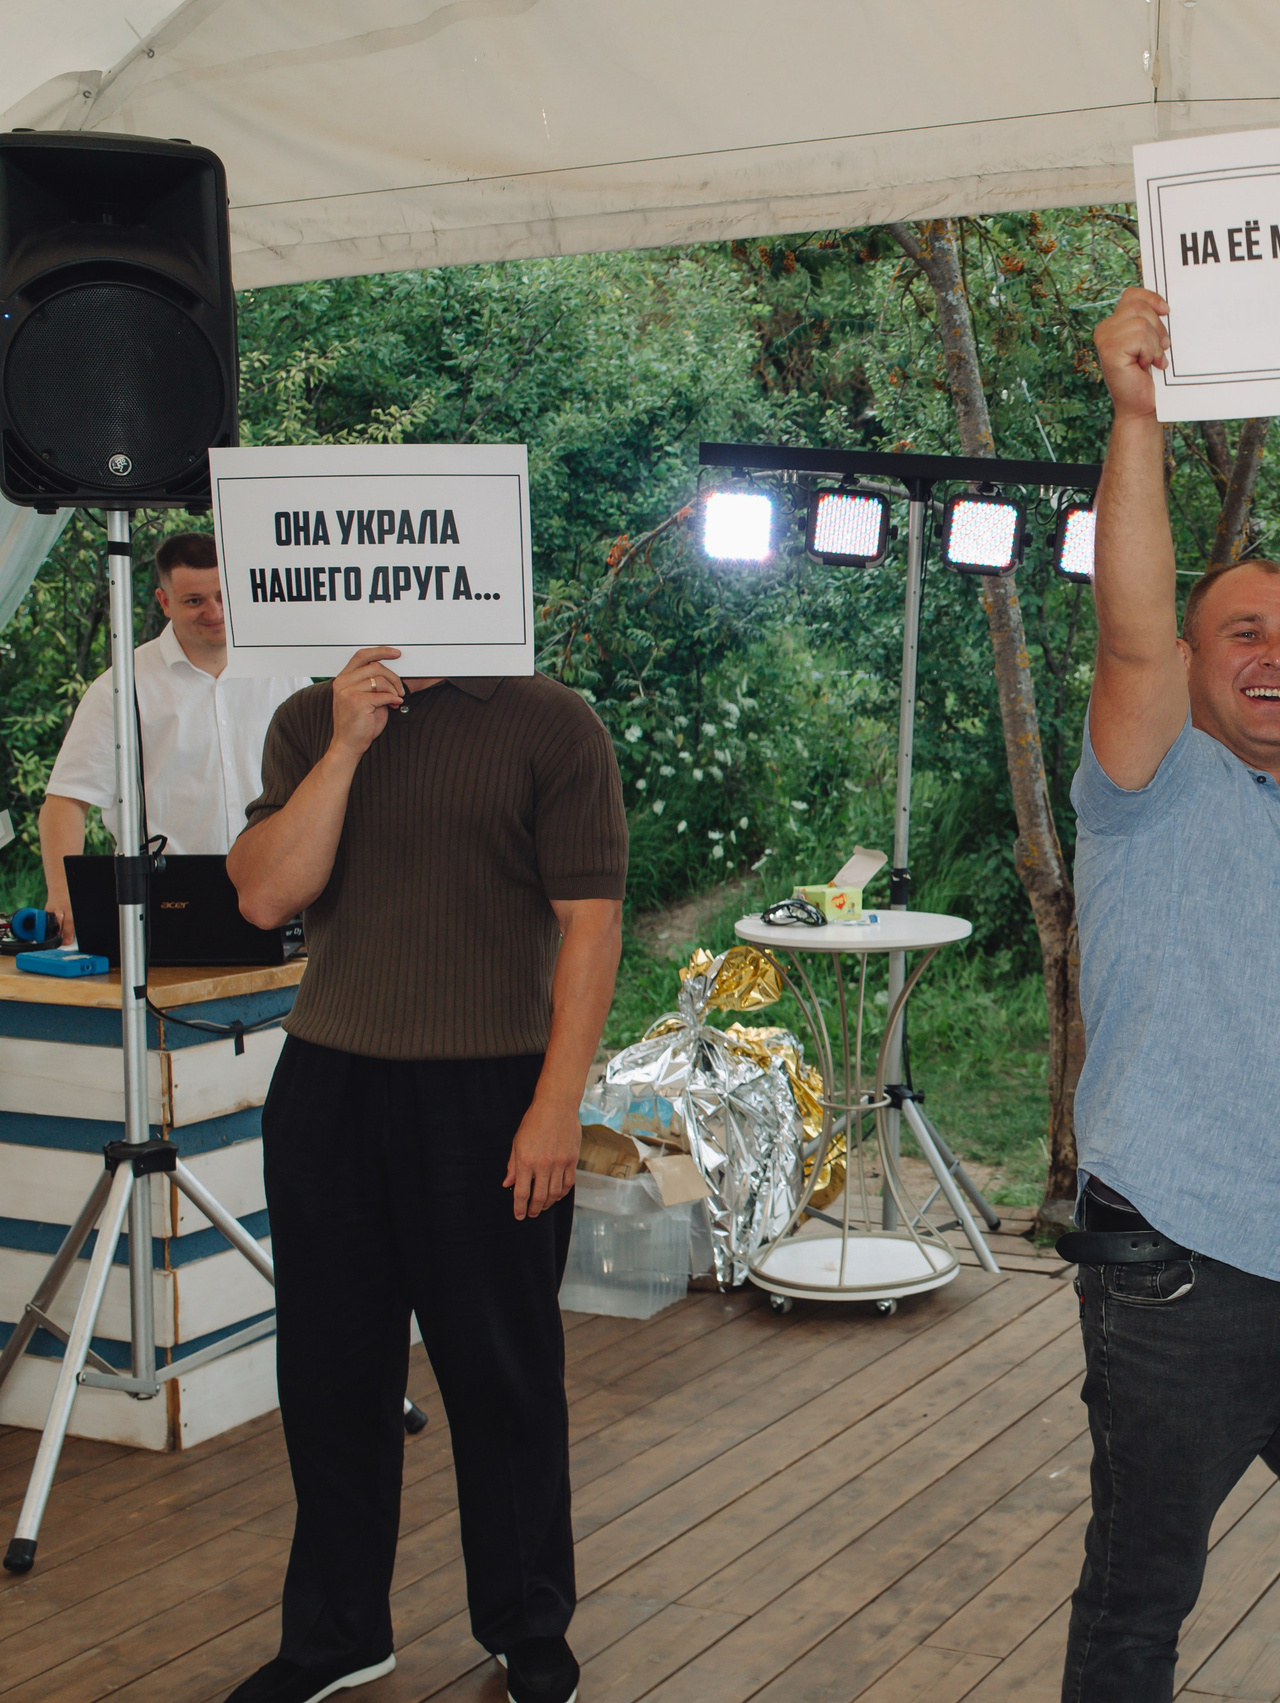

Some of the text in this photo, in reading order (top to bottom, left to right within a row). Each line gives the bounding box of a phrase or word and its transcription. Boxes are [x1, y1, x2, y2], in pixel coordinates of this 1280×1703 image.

[1180, 230, 1221, 266] НА
[1227, 220, 1263, 262] ЕЁ
[274, 509, 460, 547] ОНА УКРАЛА
[249, 565, 501, 604] НАШЕГО ДРУГА...
[160, 901, 189, 909] acer
